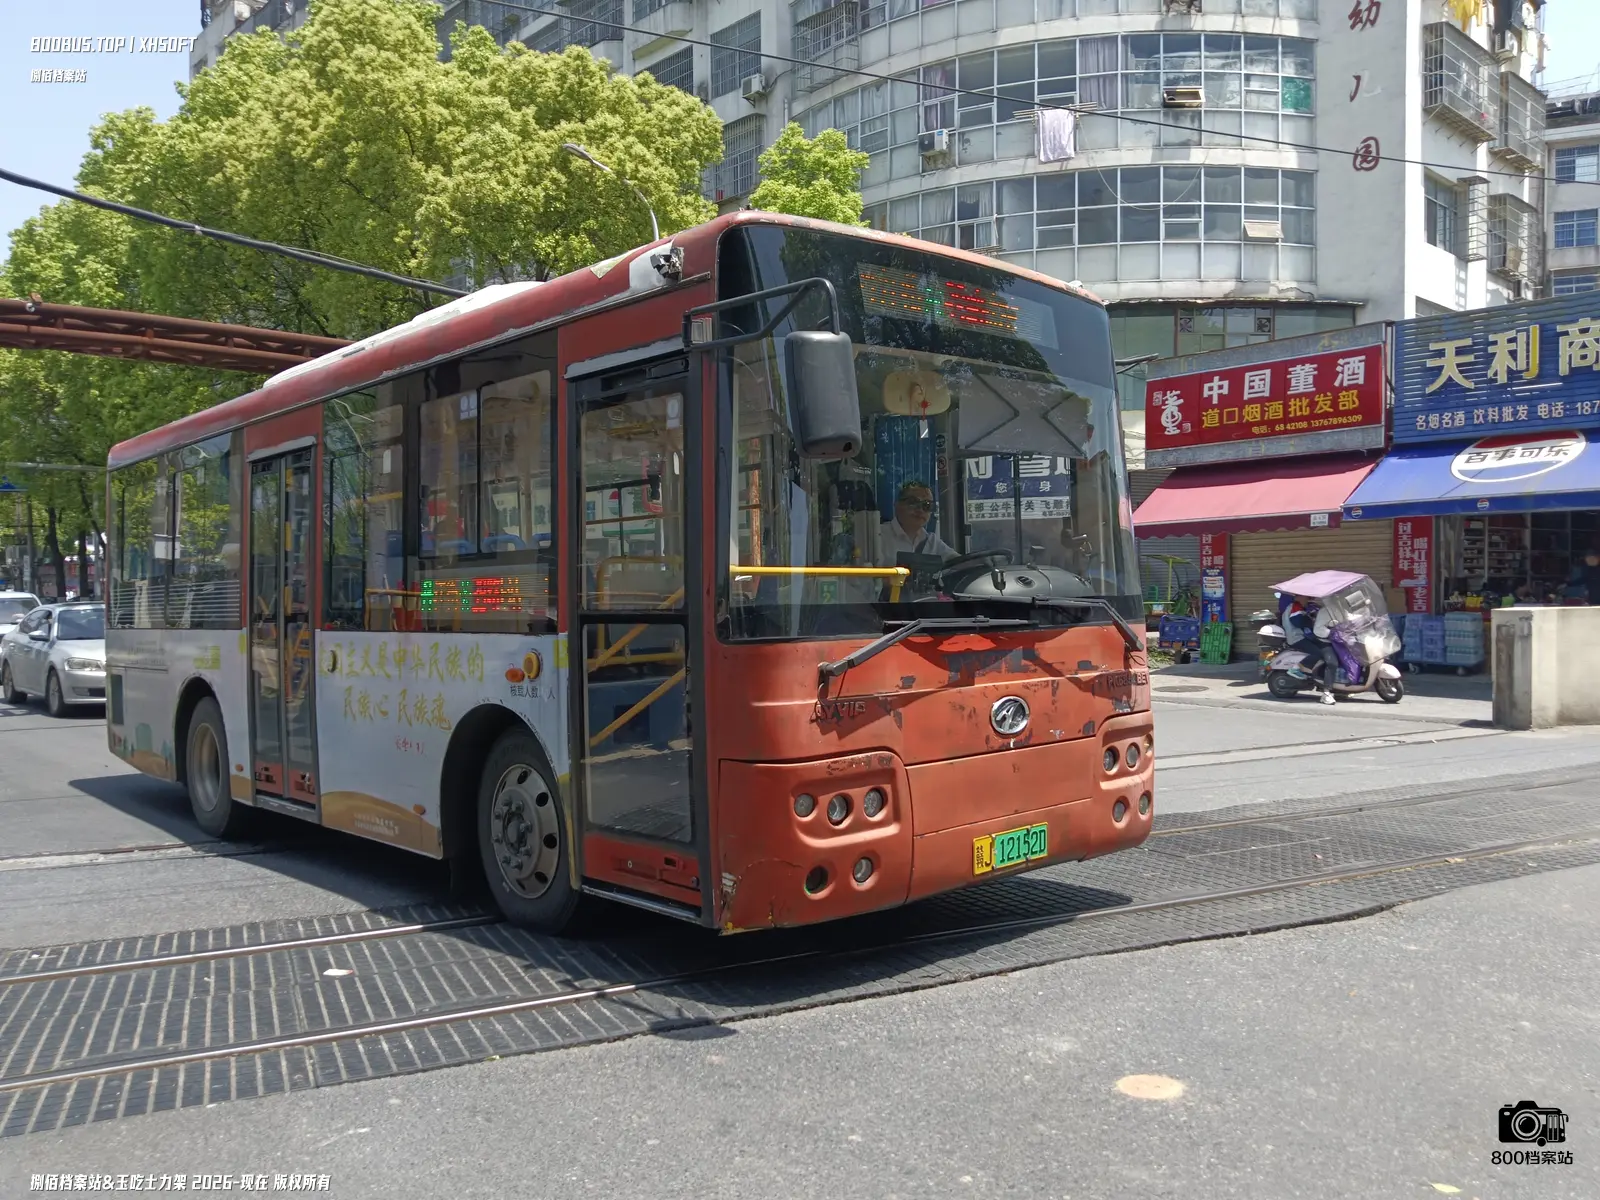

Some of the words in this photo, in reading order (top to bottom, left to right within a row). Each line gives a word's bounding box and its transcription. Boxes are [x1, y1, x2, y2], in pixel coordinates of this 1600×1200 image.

[1203, 355, 1366, 404] 中国董酒
[1202, 389, 1360, 429] 道口烟酒批发部
[1415, 410, 1465, 431] 名烟名酒
[1473, 404, 1529, 425] 饮料批发
[1464, 444, 1571, 464] 百事可乐
[1202, 533, 1212, 569] 过吉祥
[1413, 537, 1428, 612] 喝红罐老吉
